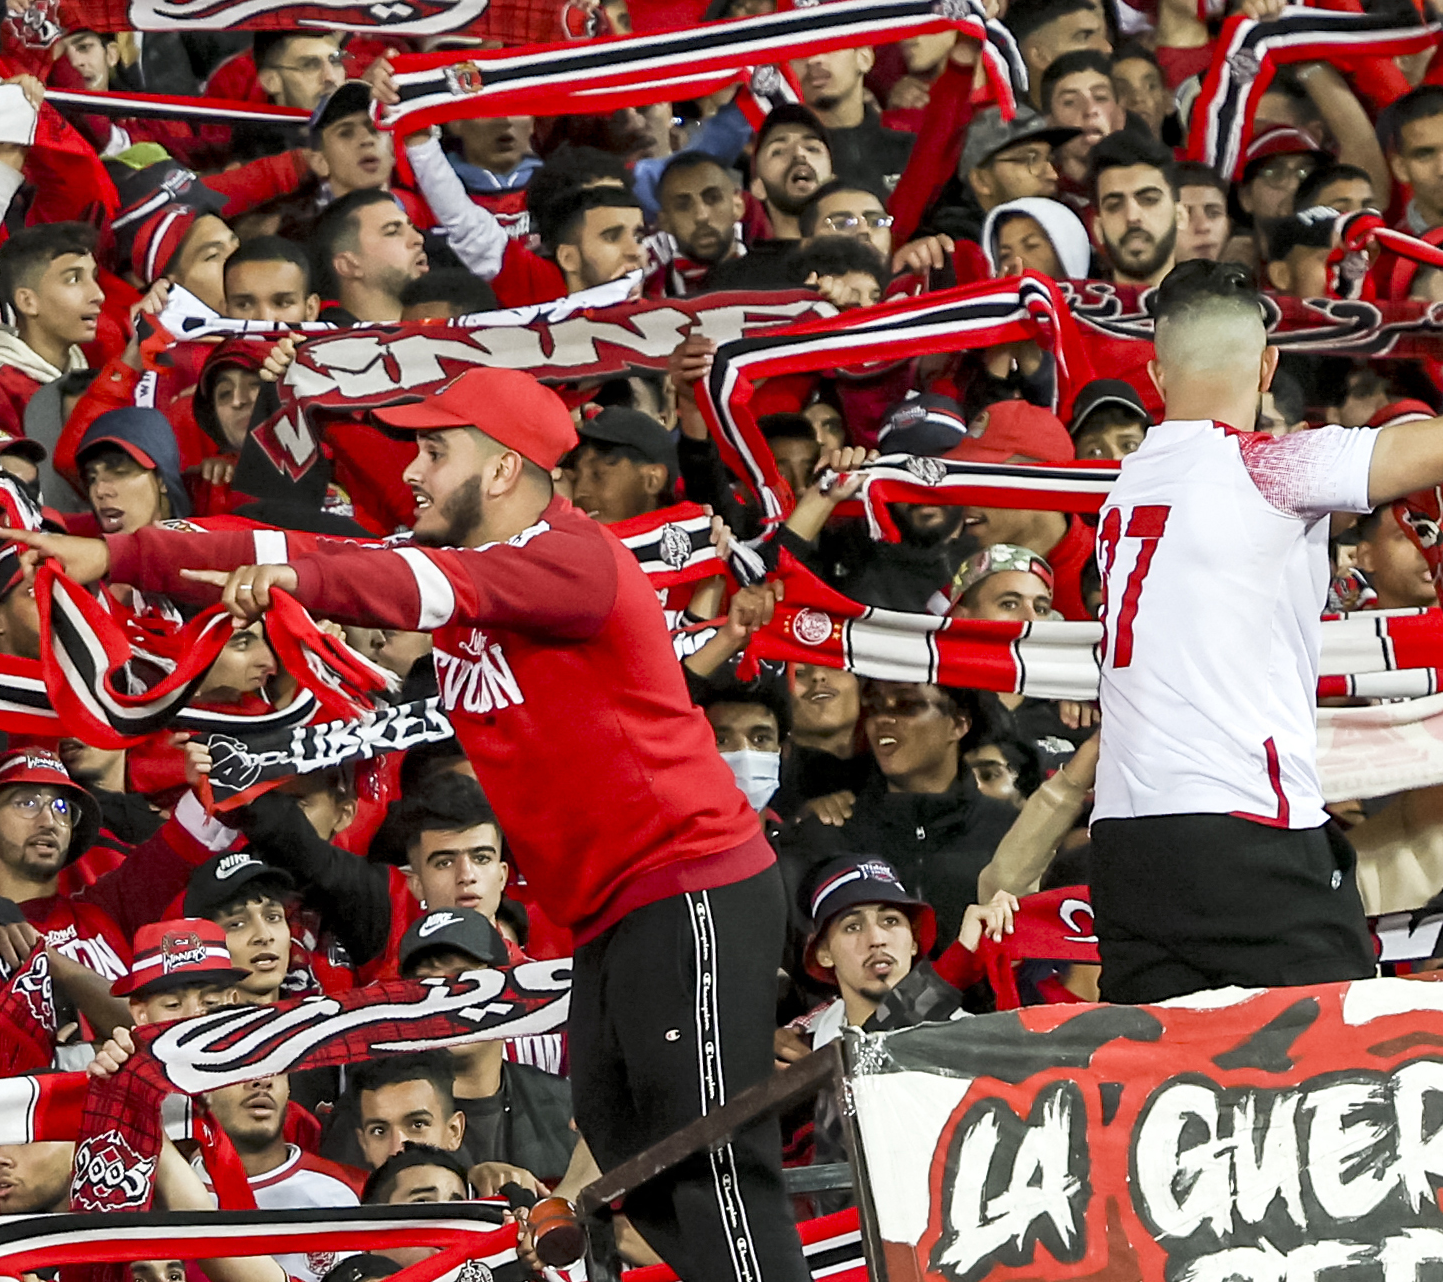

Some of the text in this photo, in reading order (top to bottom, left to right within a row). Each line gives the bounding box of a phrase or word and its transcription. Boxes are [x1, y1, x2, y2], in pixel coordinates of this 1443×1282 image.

[219, 854, 252, 869] NIKE
[161, 947, 207, 974] WINNERS
[695, 901, 711, 962] Champion
[701, 971, 713, 1032] Champion
[704, 1040, 718, 1101] Champion
[72, 1141, 156, 1200] 2005
[931, 1080, 1084, 1279] LA
[722, 1172, 739, 1230] Champion
